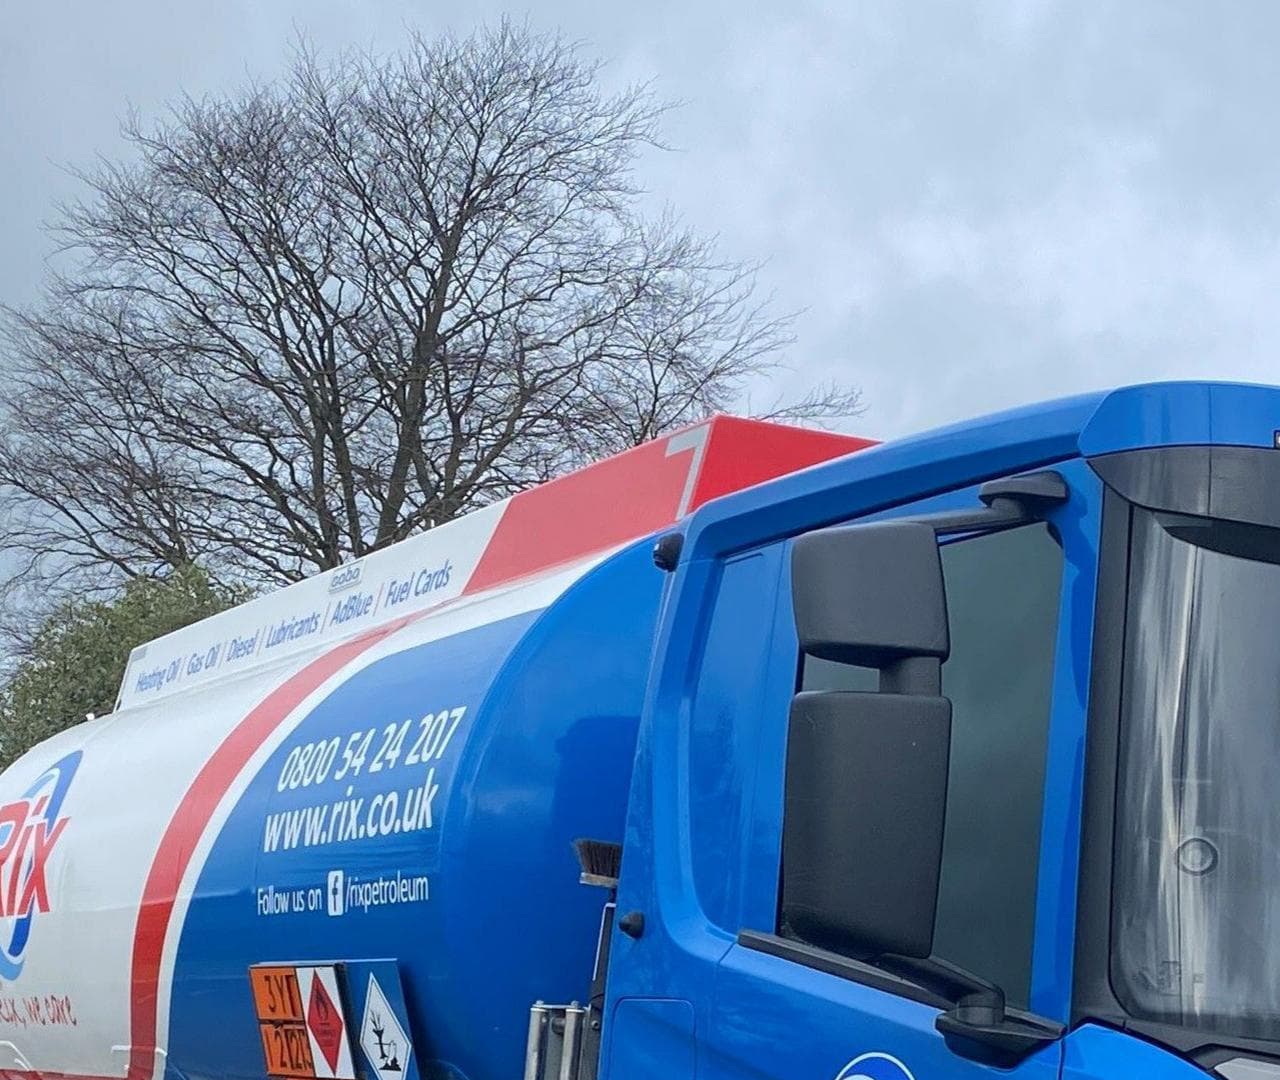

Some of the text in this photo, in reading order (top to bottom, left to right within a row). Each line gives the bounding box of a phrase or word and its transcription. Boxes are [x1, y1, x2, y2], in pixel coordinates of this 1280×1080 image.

[187, 652, 205, 676] Gas
[205, 643, 221, 670] Oil
[226, 628, 260, 662] Diesel
[265, 611, 320, 649] Lubricants
[329, 593, 373, 627] AdBlue
[384, 571, 416, 609] Fuel
[414, 558, 453, 597] Cards
[277, 705, 468, 793] 0800 54 24 207
[263, 767, 439, 853] www.rix.co.uk
[257, 884, 290, 916] Follow
[292, 888, 305, 912] us
[307, 887, 322, 911] on
[344, 870, 429, 914] /rixpetroleum
